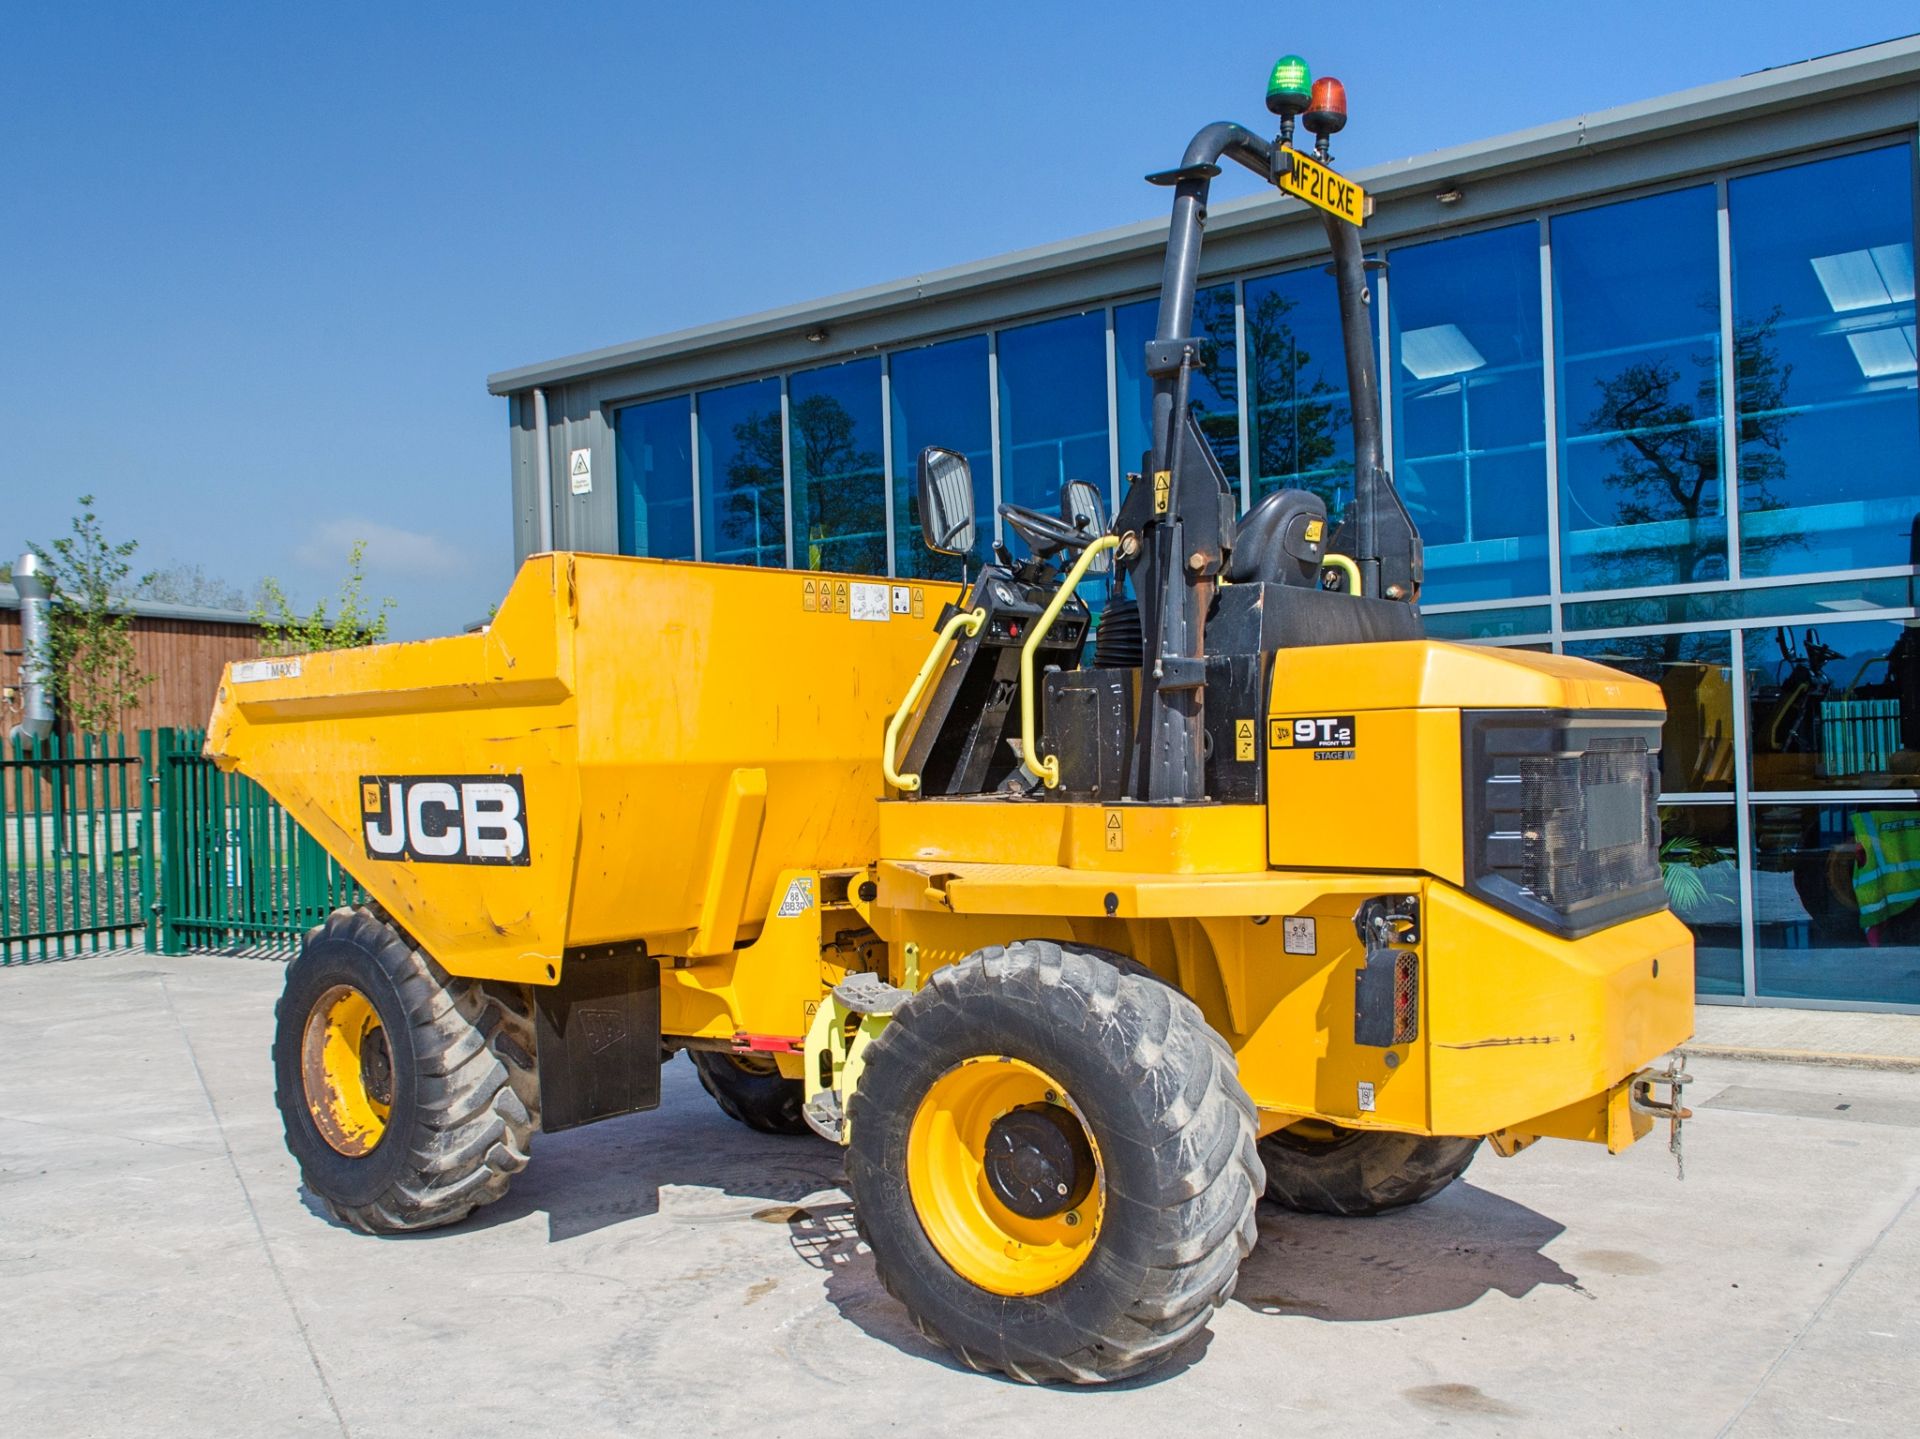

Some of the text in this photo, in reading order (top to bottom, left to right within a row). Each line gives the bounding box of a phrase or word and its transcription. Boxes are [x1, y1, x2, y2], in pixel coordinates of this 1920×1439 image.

[1291, 159, 1355, 216] MF21 CXE
[271, 663, 292, 677] MAX
[1315, 751, 1343, 760] STAGE
[365, 782, 524, 858] JCB
